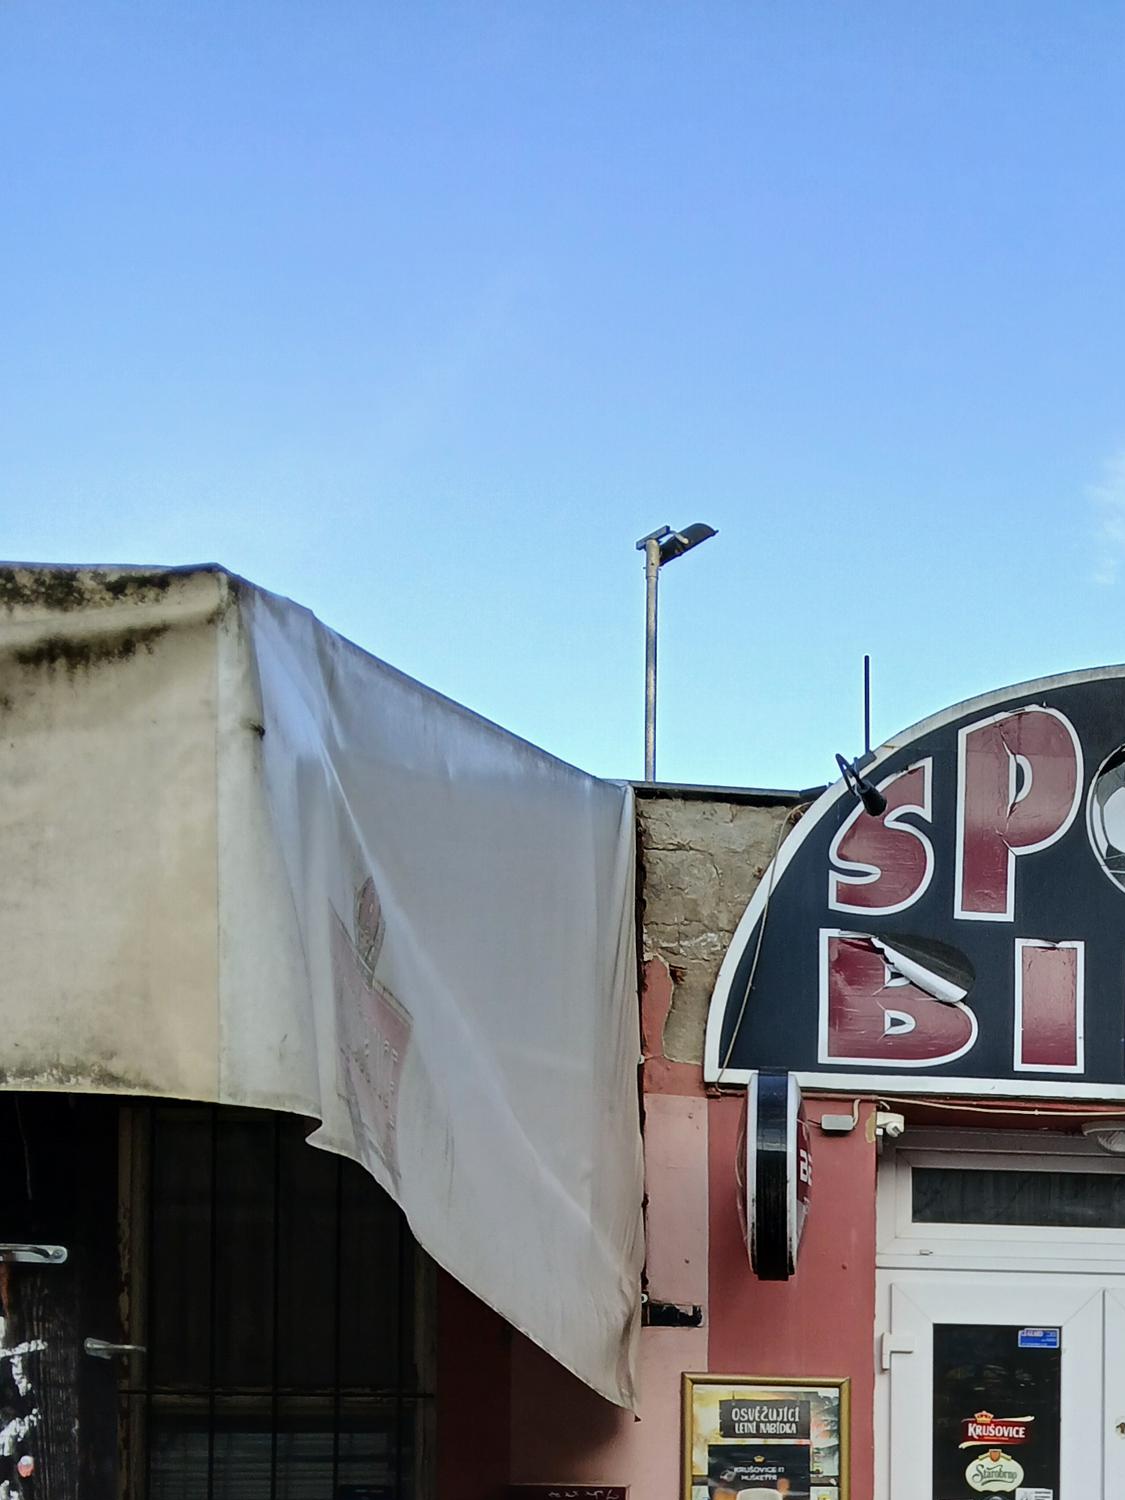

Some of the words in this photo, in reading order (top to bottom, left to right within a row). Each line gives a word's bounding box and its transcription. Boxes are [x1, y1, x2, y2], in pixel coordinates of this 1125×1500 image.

[735, 1421, 756, 1434] LETNÍ
[759, 1421, 797, 1434] NABÍDKA
[967, 1423, 1026, 1439] KRUŠOVICE
